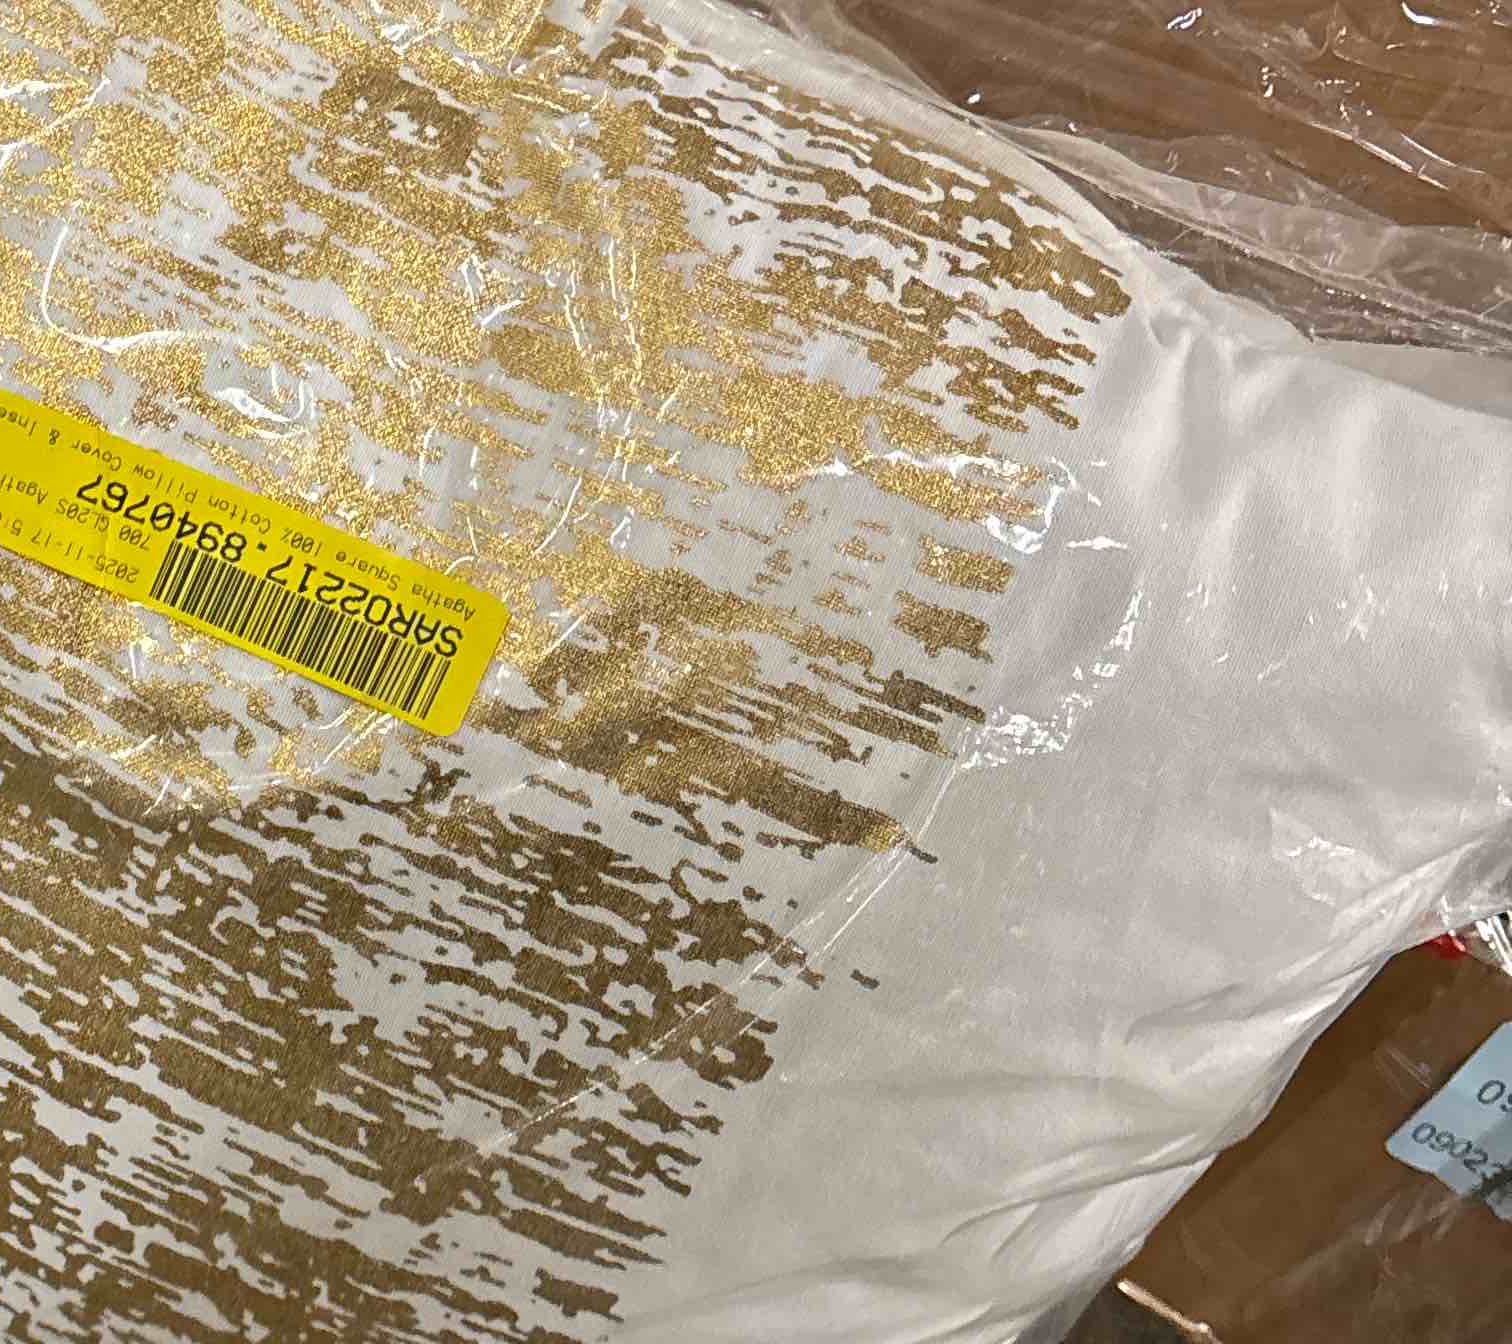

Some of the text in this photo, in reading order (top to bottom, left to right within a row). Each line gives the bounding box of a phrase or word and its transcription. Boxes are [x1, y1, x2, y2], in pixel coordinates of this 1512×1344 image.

[49, 429, 60, 446] &
[70, 438, 123, 473] Cover
[132, 464, 199, 505] Pillow
[209, 496, 271, 535] Cotton
[31, 530, 139, 584] 2025-11-17
[119, 526, 151, 550] 700
[279, 528, 323, 558] 100%
[336, 552, 401, 591] Square
[412, 584, 476, 622] Agatha
